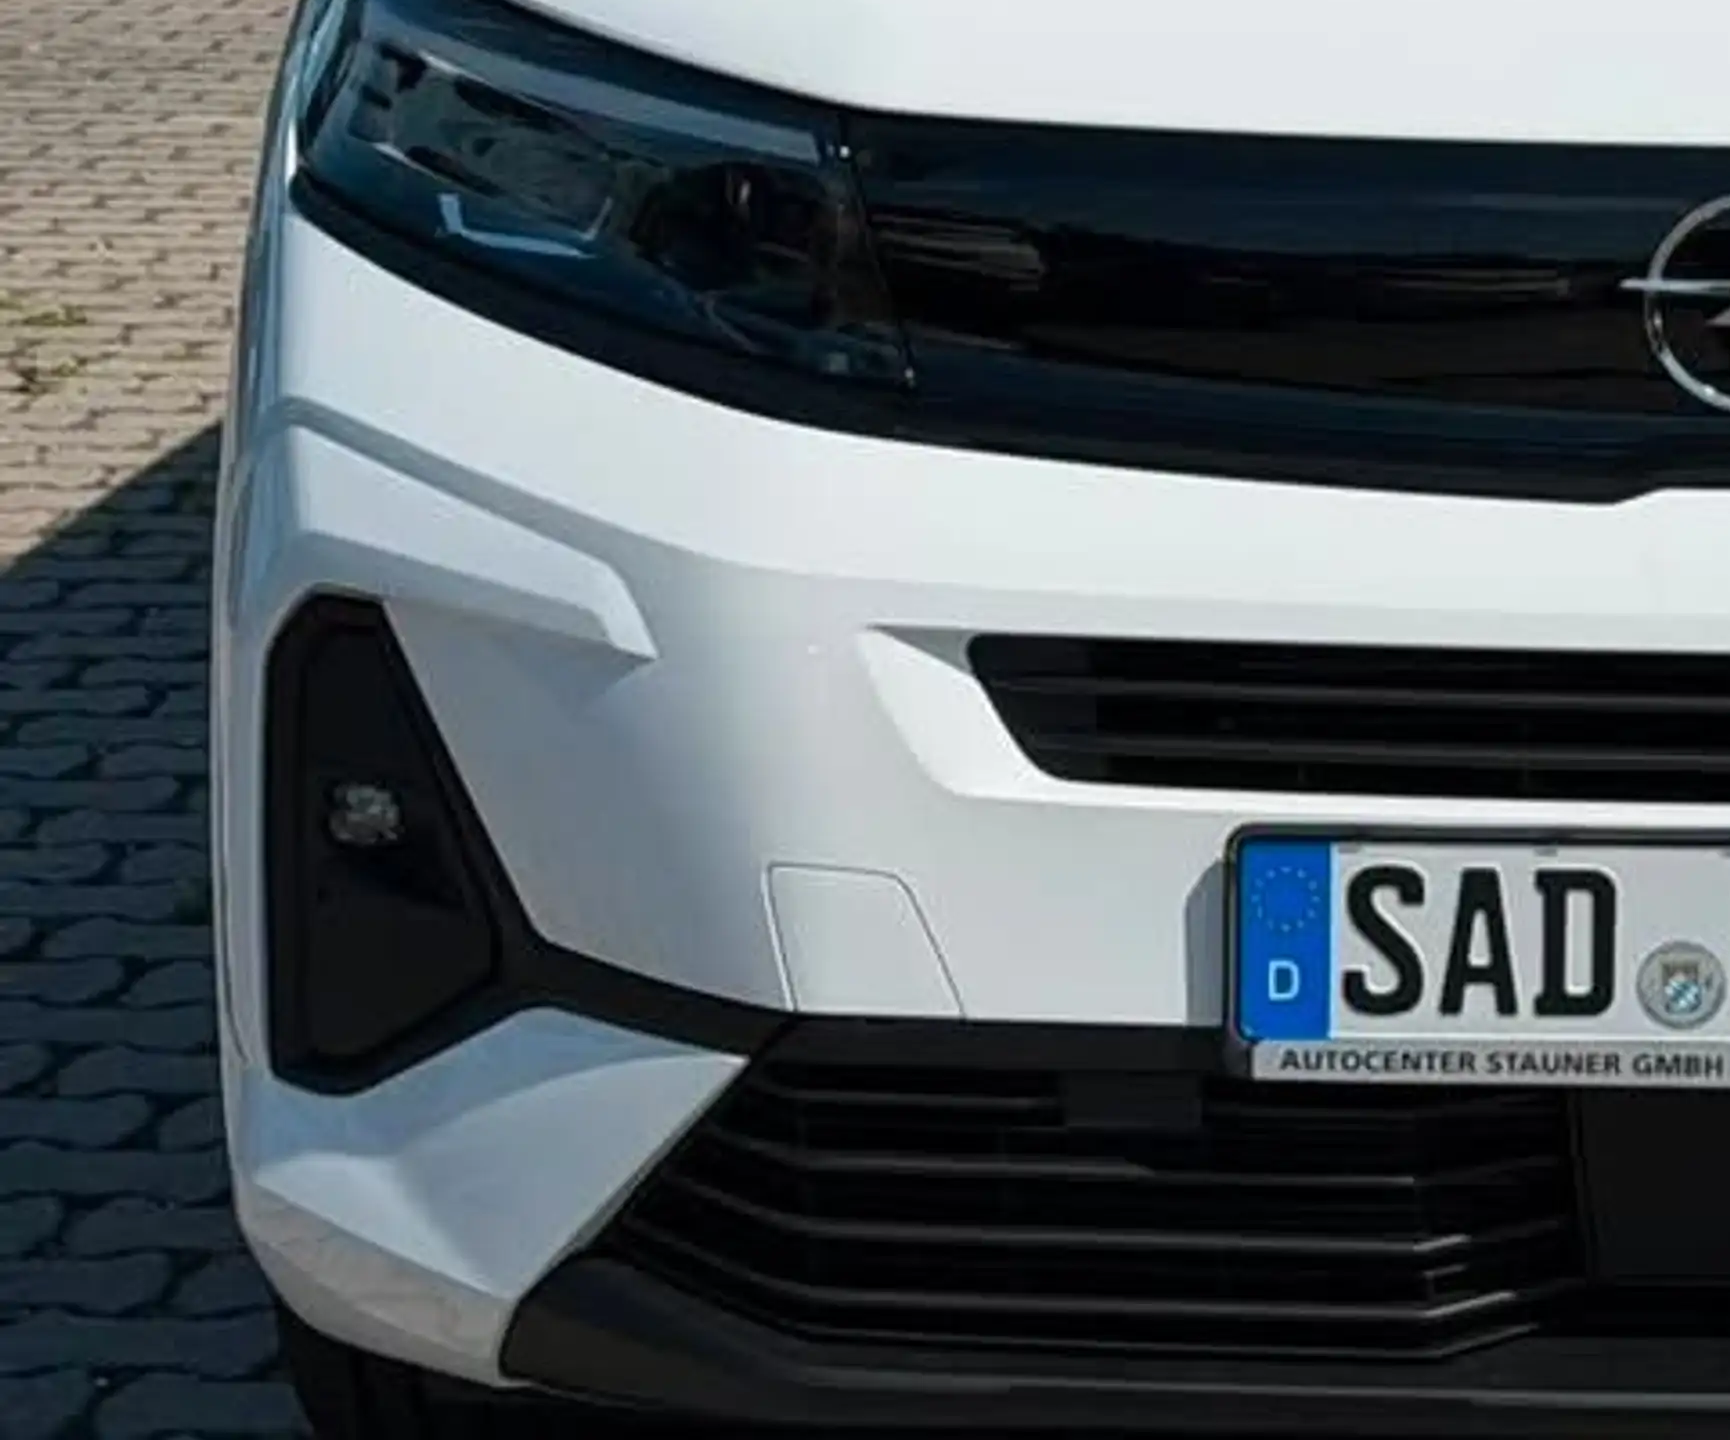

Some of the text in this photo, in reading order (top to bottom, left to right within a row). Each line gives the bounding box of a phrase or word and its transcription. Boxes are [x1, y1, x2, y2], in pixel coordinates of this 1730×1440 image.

[1342, 866, 1617, 1017] SAD
[1268, 960, 1300, 1001] D
[1280, 1049, 1476, 1074] AUTOCENTER
[1486, 1052, 1622, 1076] STAUNER
[1632, 1054, 1724, 1077] GMBH
